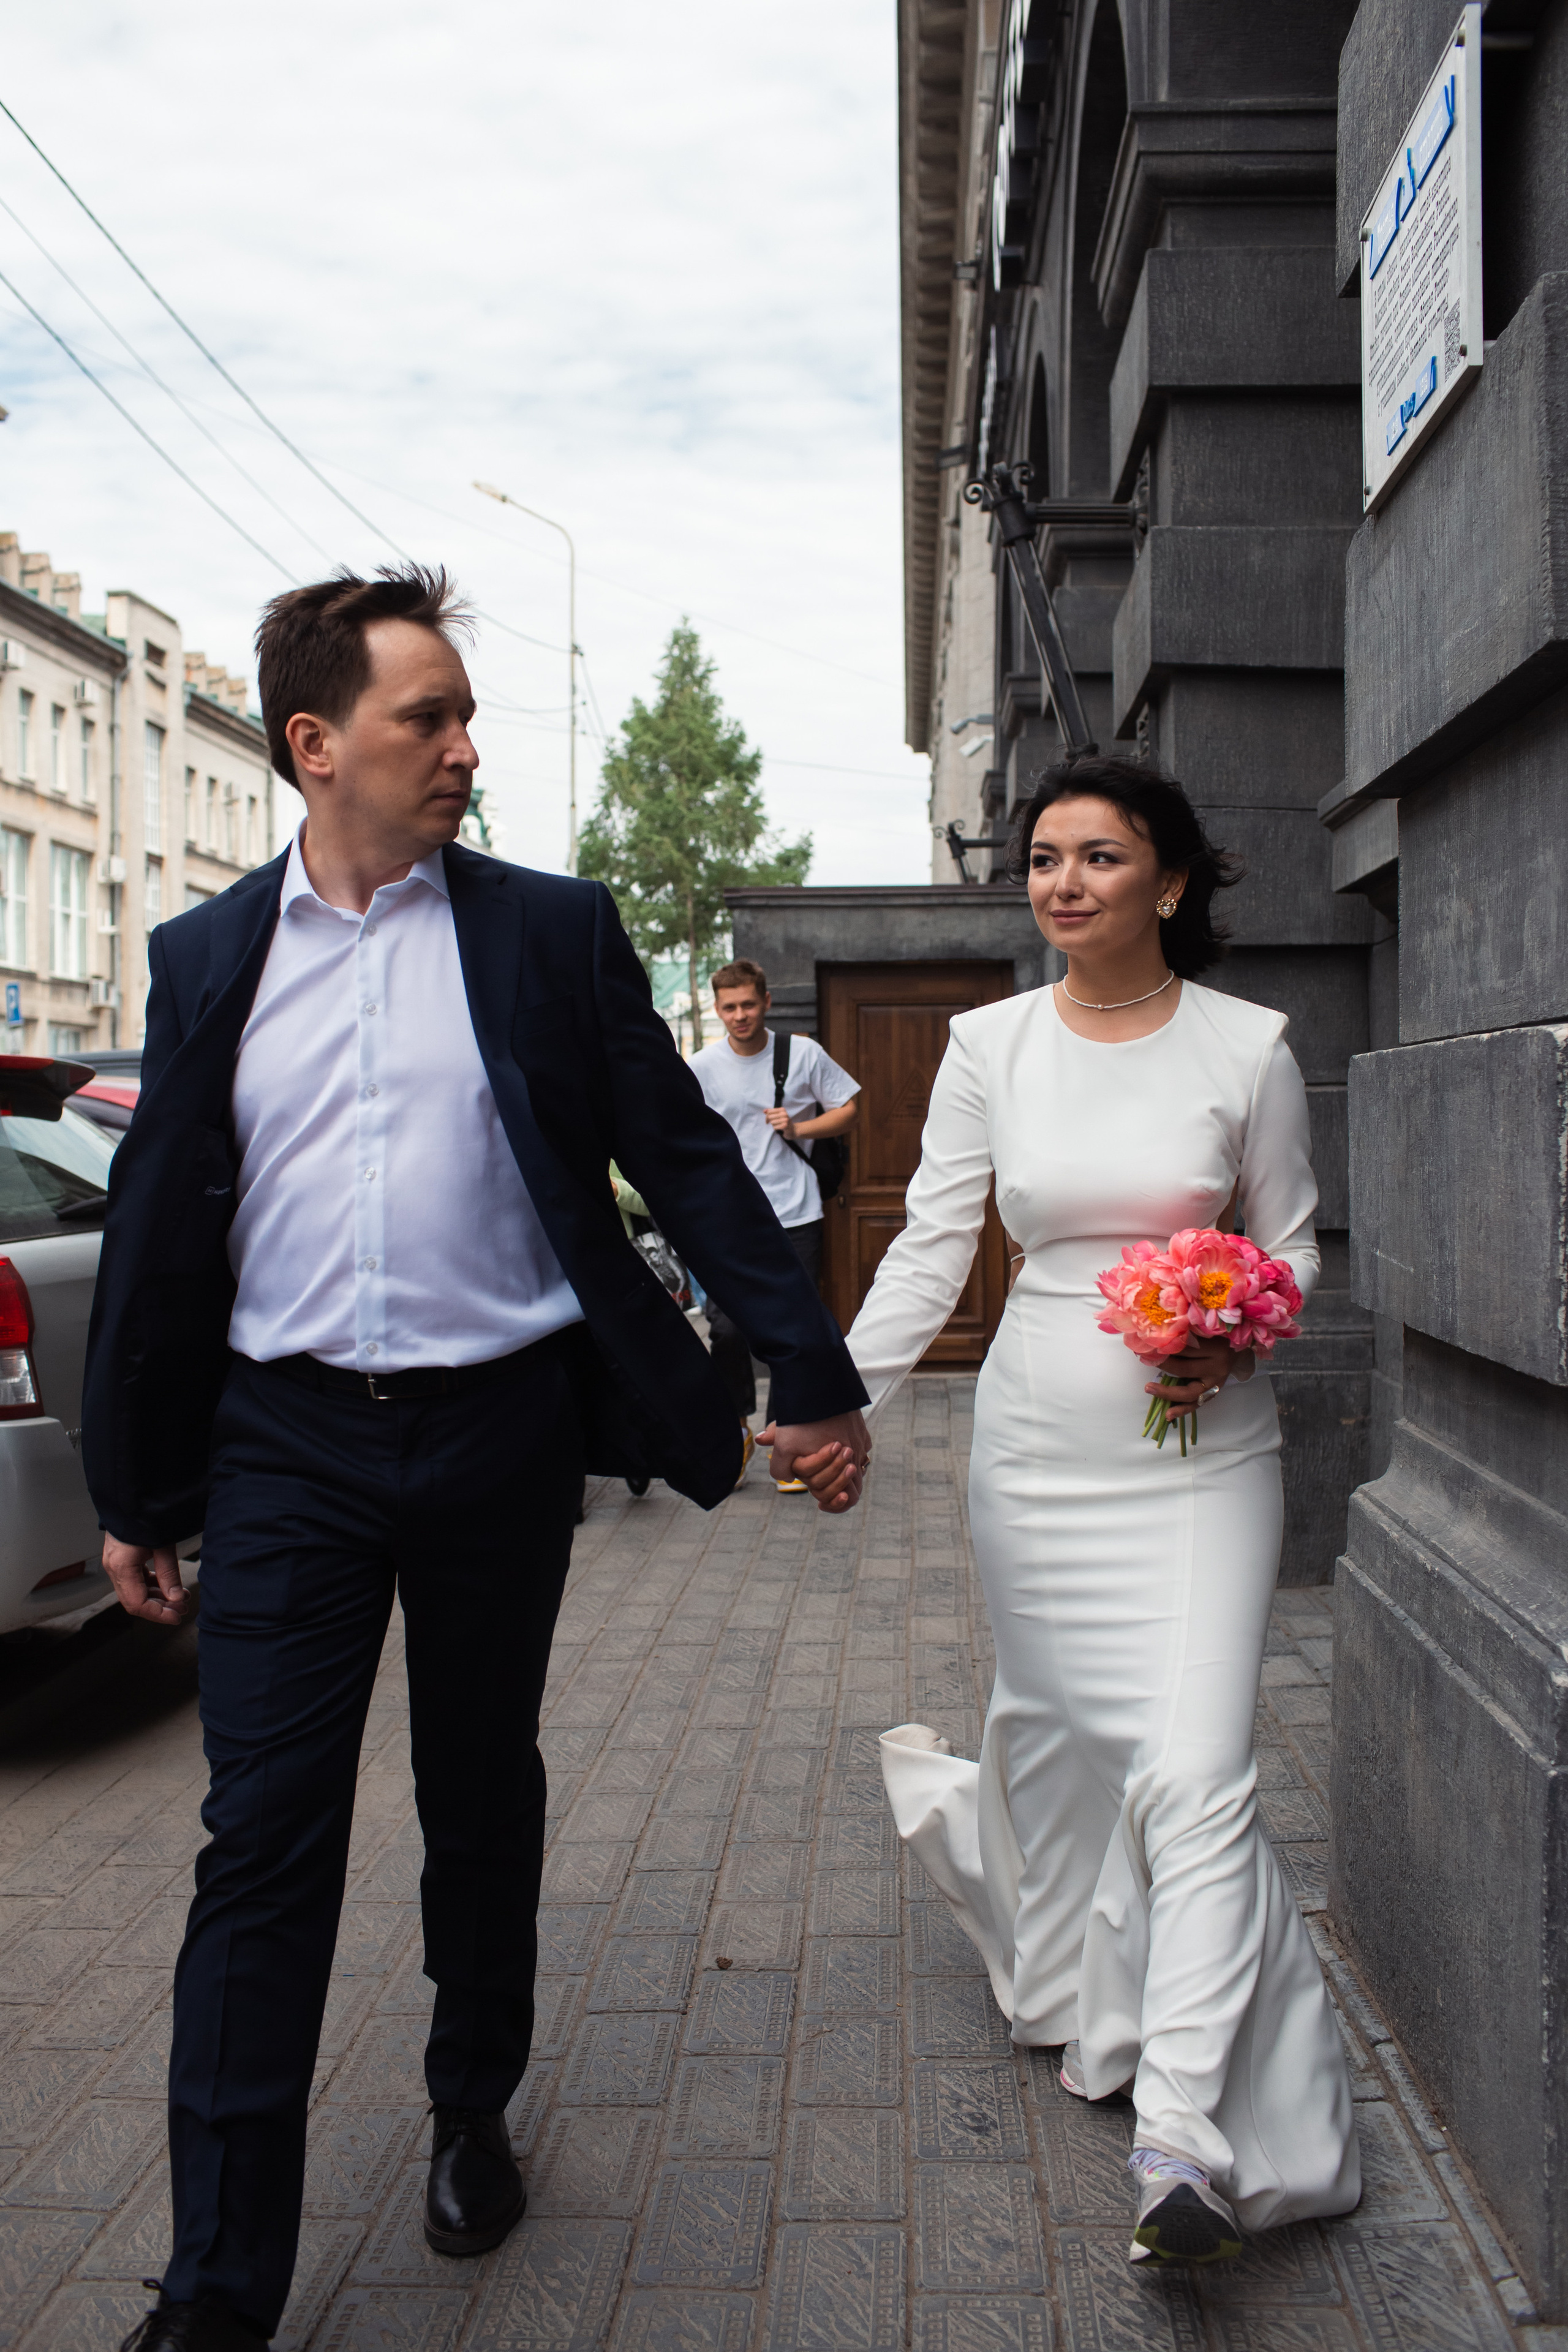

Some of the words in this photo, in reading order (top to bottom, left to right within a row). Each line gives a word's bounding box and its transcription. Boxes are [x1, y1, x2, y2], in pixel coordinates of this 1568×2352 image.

[1375, 298, 1387, 329] Омского
[1388, 275, 1400, 306] отдела
[1401, 255, 1410, 283] Союза
[1411, 211, 1435, 263] Возрождения
[1381, 312, 1392, 343] печати
[1400, 279, 1411, 309] Совете
[1412, 242, 1432, 287] министров
[1434, 198, 1458, 251] Российского
[1387, 255, 1397, 284] здании
[1400, 216, 1419, 260] находилась
[1420, 156, 1451, 223] штаб-квартира
[1412, 271, 1430, 312] заседания
[1377, 341, 1404, 397] художественного
[1405, 317, 1418, 350] кружка
[1381, 378, 1396, 416] участием
[1397, 356, 1409, 386] видных
[1410, 325, 1427, 365] деятелей
[1428, 295, 1449, 338] культуры
